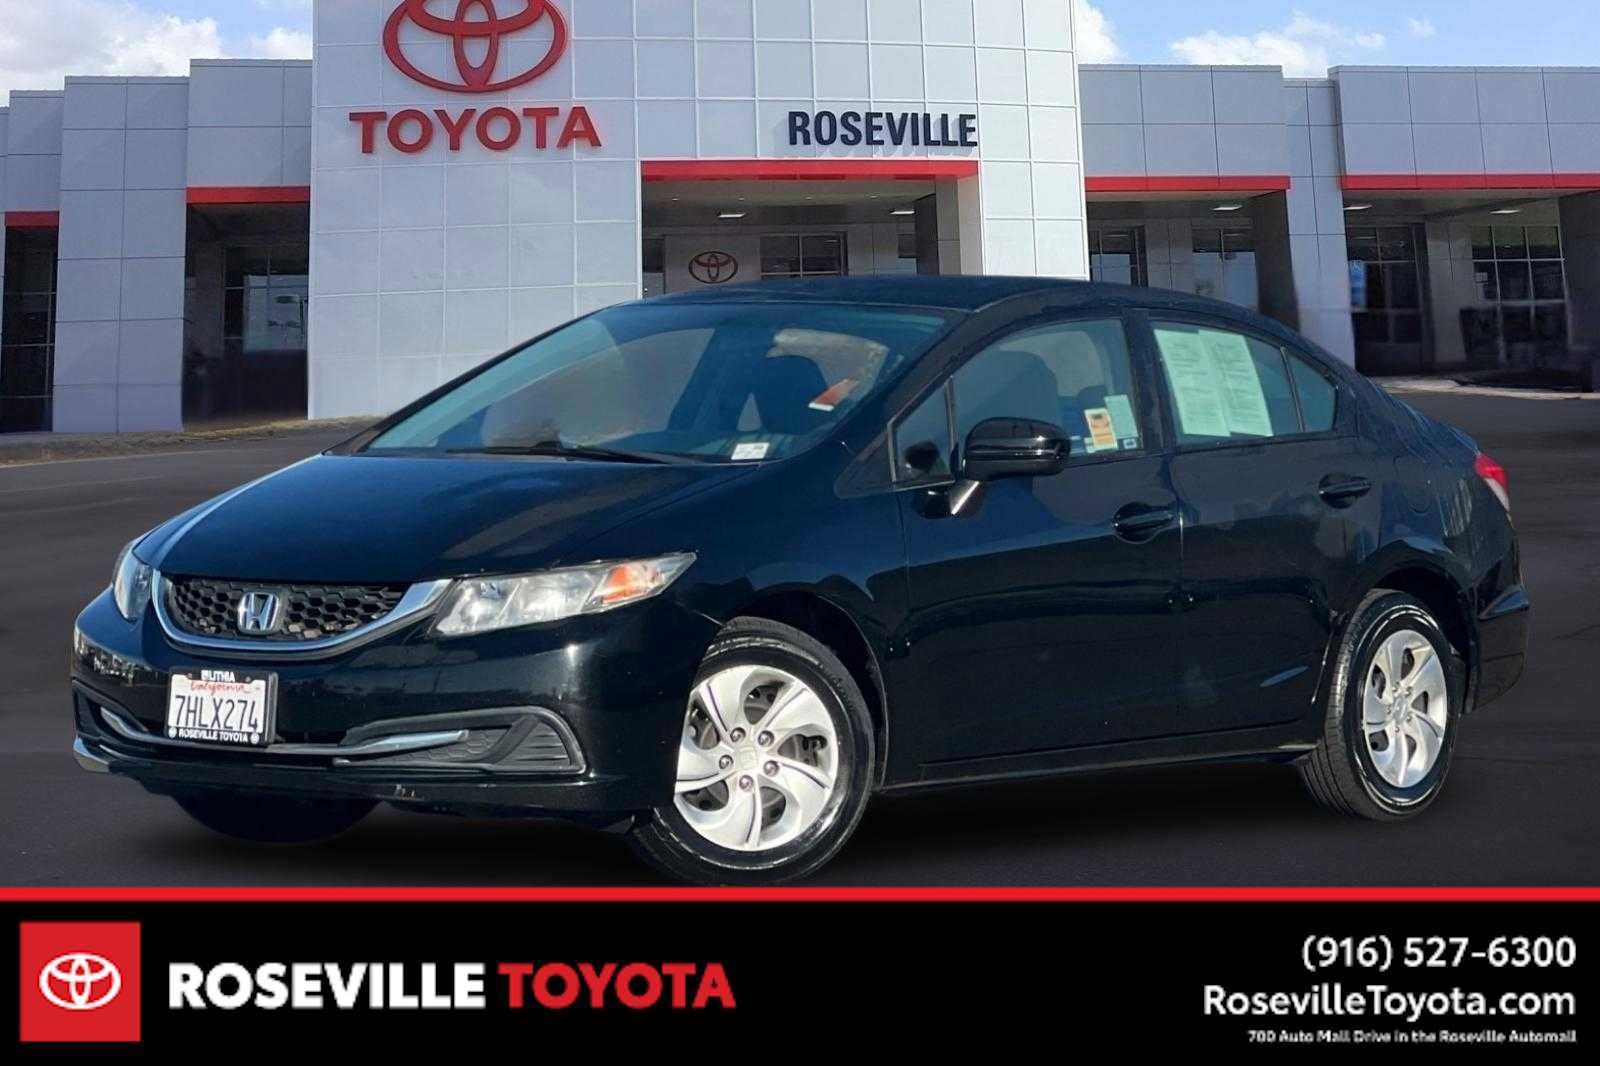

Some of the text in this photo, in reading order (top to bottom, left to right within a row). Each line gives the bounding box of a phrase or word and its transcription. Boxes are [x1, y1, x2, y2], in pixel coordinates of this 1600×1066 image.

[349, 106, 602, 154] TOYOTA
[788, 111, 978, 147] ROSEVILLE
[175, 694, 258, 733] 7HLX274
[178, 729, 248, 743] ROSEVILLE TOYOTA
